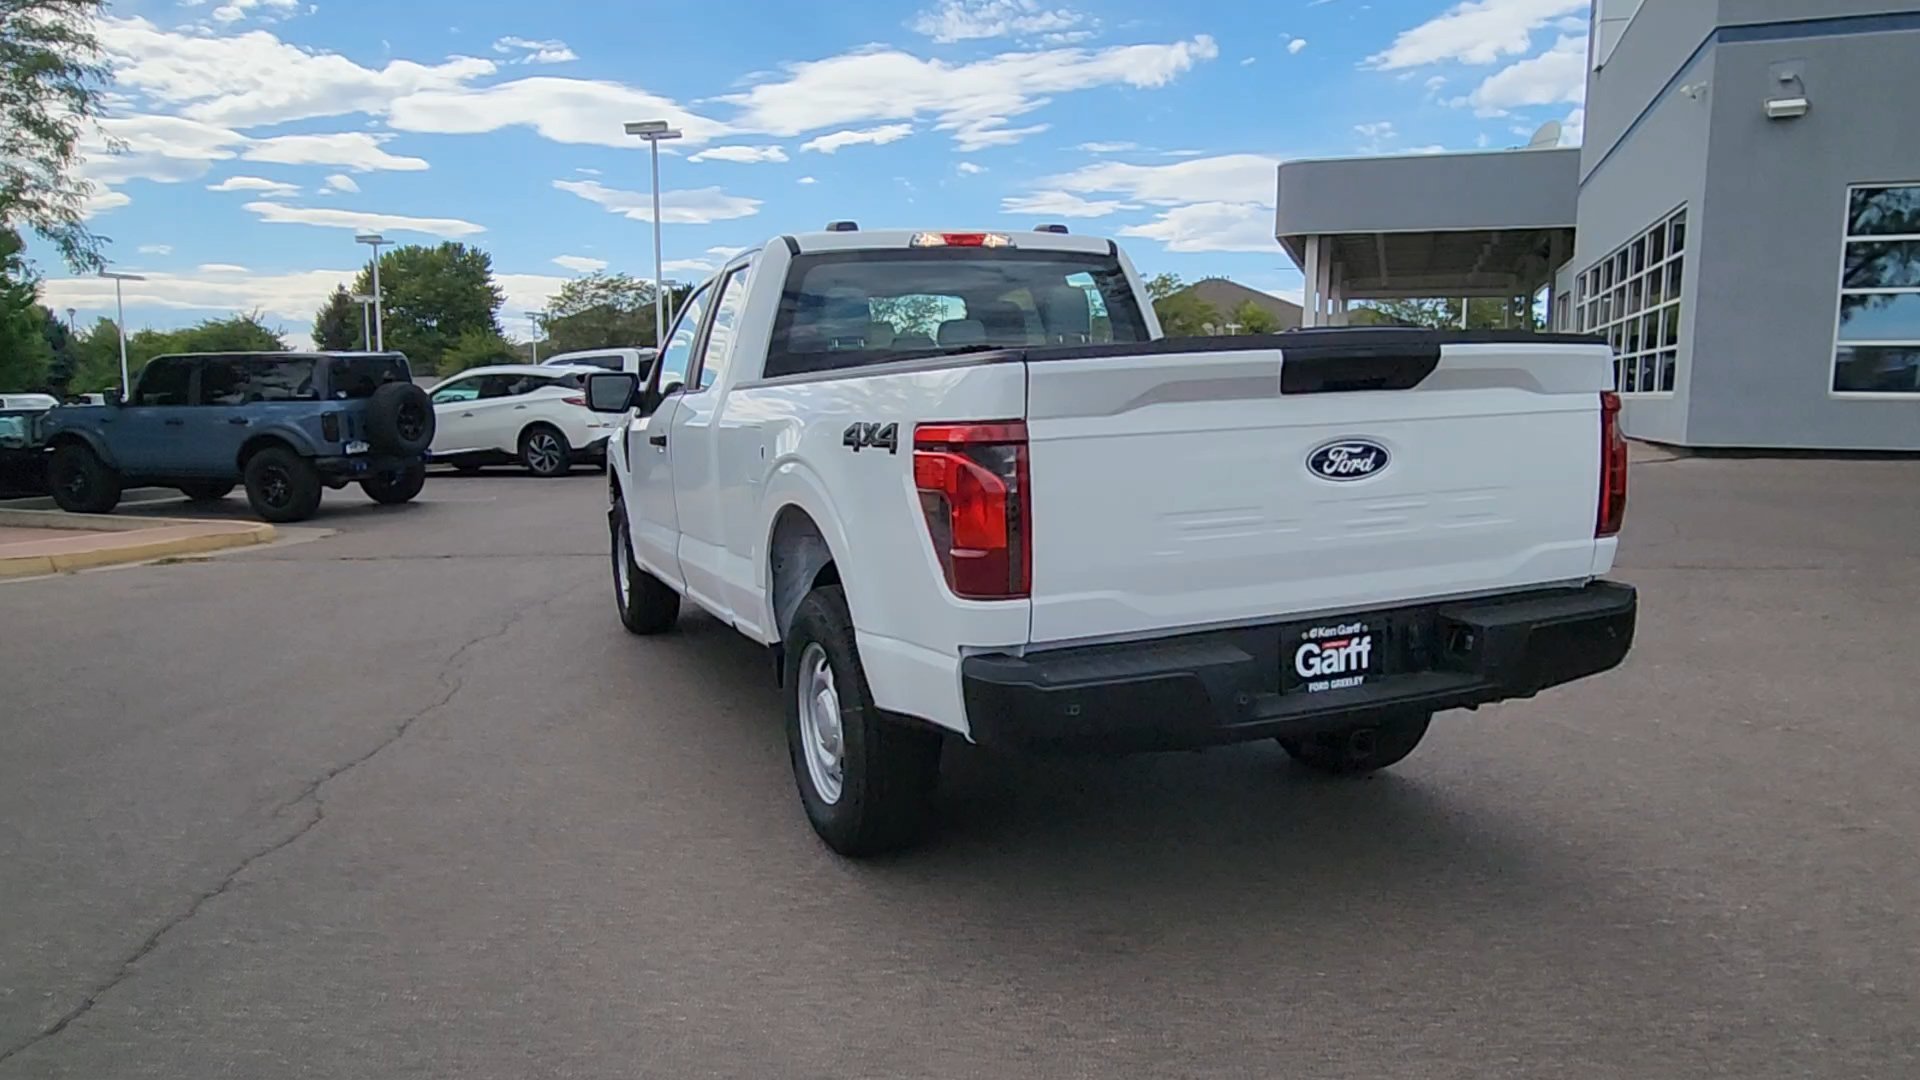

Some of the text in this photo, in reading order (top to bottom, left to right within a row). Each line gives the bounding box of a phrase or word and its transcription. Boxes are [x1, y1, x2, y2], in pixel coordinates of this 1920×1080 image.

[1323, 446, 1377, 474] Ford
[1295, 635, 1371, 677] Garff
[1308, 676, 1364, 693] FORD GREELEY
